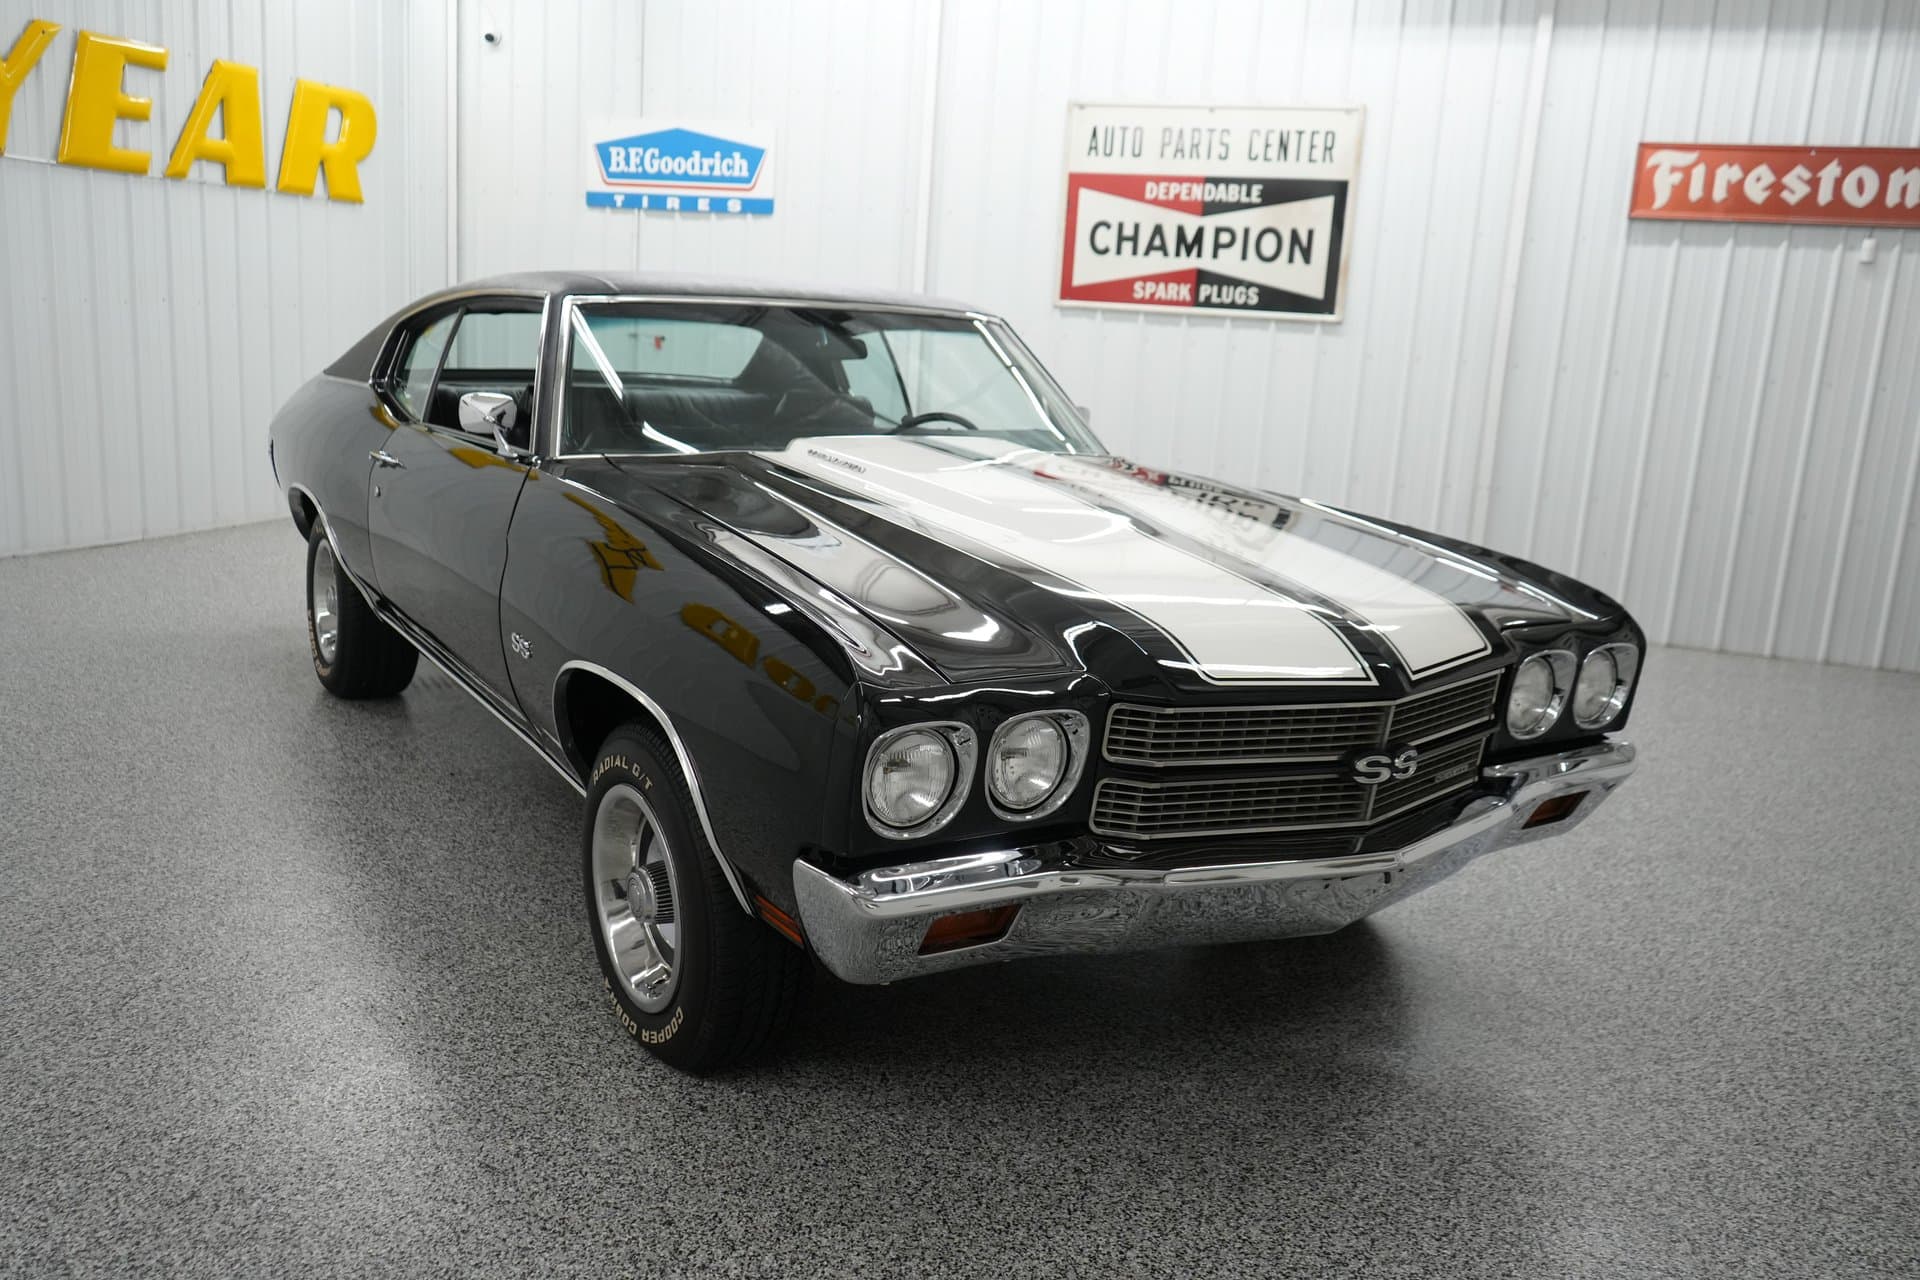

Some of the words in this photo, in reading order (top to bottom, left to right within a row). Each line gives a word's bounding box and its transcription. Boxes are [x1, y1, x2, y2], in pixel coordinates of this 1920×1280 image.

[1087, 125, 1144, 158] AUTO
[1160, 127, 1231, 161] PARTS
[1247, 129, 1337, 164] CENTER
[614, 194, 742, 213] TIRES
[1144, 181, 1264, 204] DEPENDABLE
[1089, 220, 1315, 265] CHAMPION
[1132, 281, 1192, 302] SPARK
[1198, 283, 1260, 306] PLUGS
[511, 632, 532, 660] SS
[593, 754, 629, 786] RADIAL
[1353, 749, 1419, 784] SS
[641, 1006, 684, 1044] COOPER
